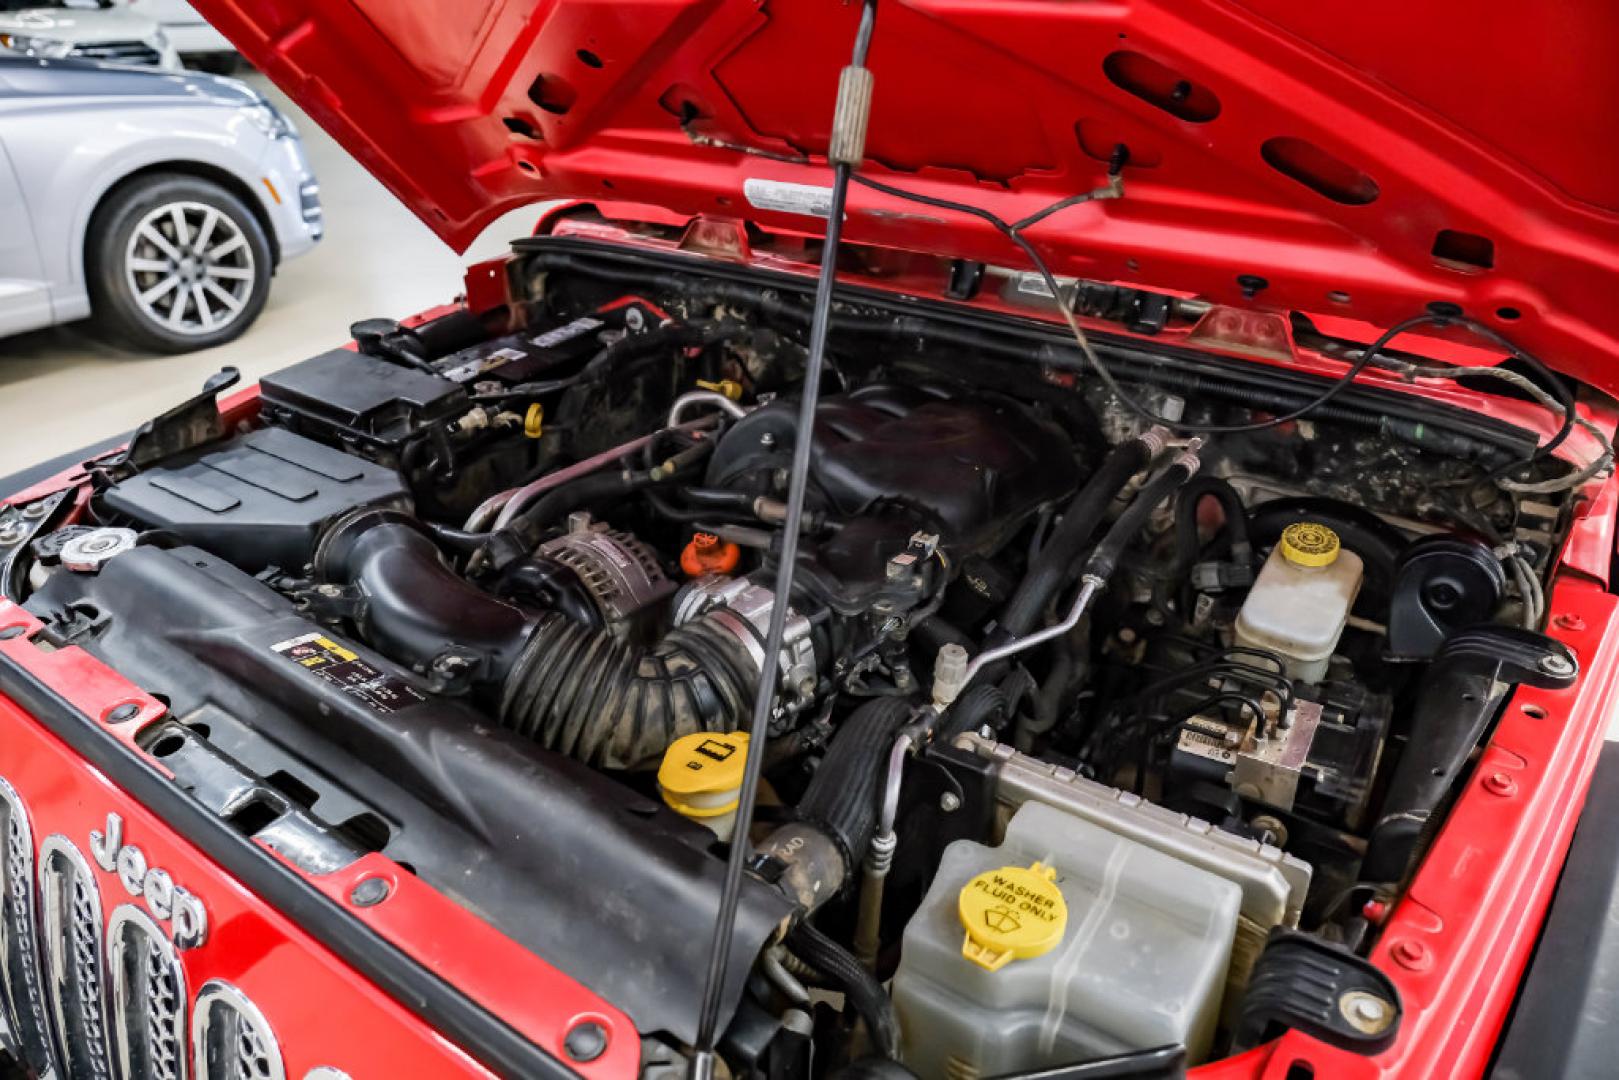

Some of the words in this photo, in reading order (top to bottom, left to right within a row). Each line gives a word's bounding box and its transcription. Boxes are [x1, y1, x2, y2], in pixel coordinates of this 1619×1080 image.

[90, 811, 208, 949] Jeep
[974, 880, 1016, 904] FLUID
[1019, 901, 1057, 922] ONLY
[993, 875, 1054, 909] WASHER
